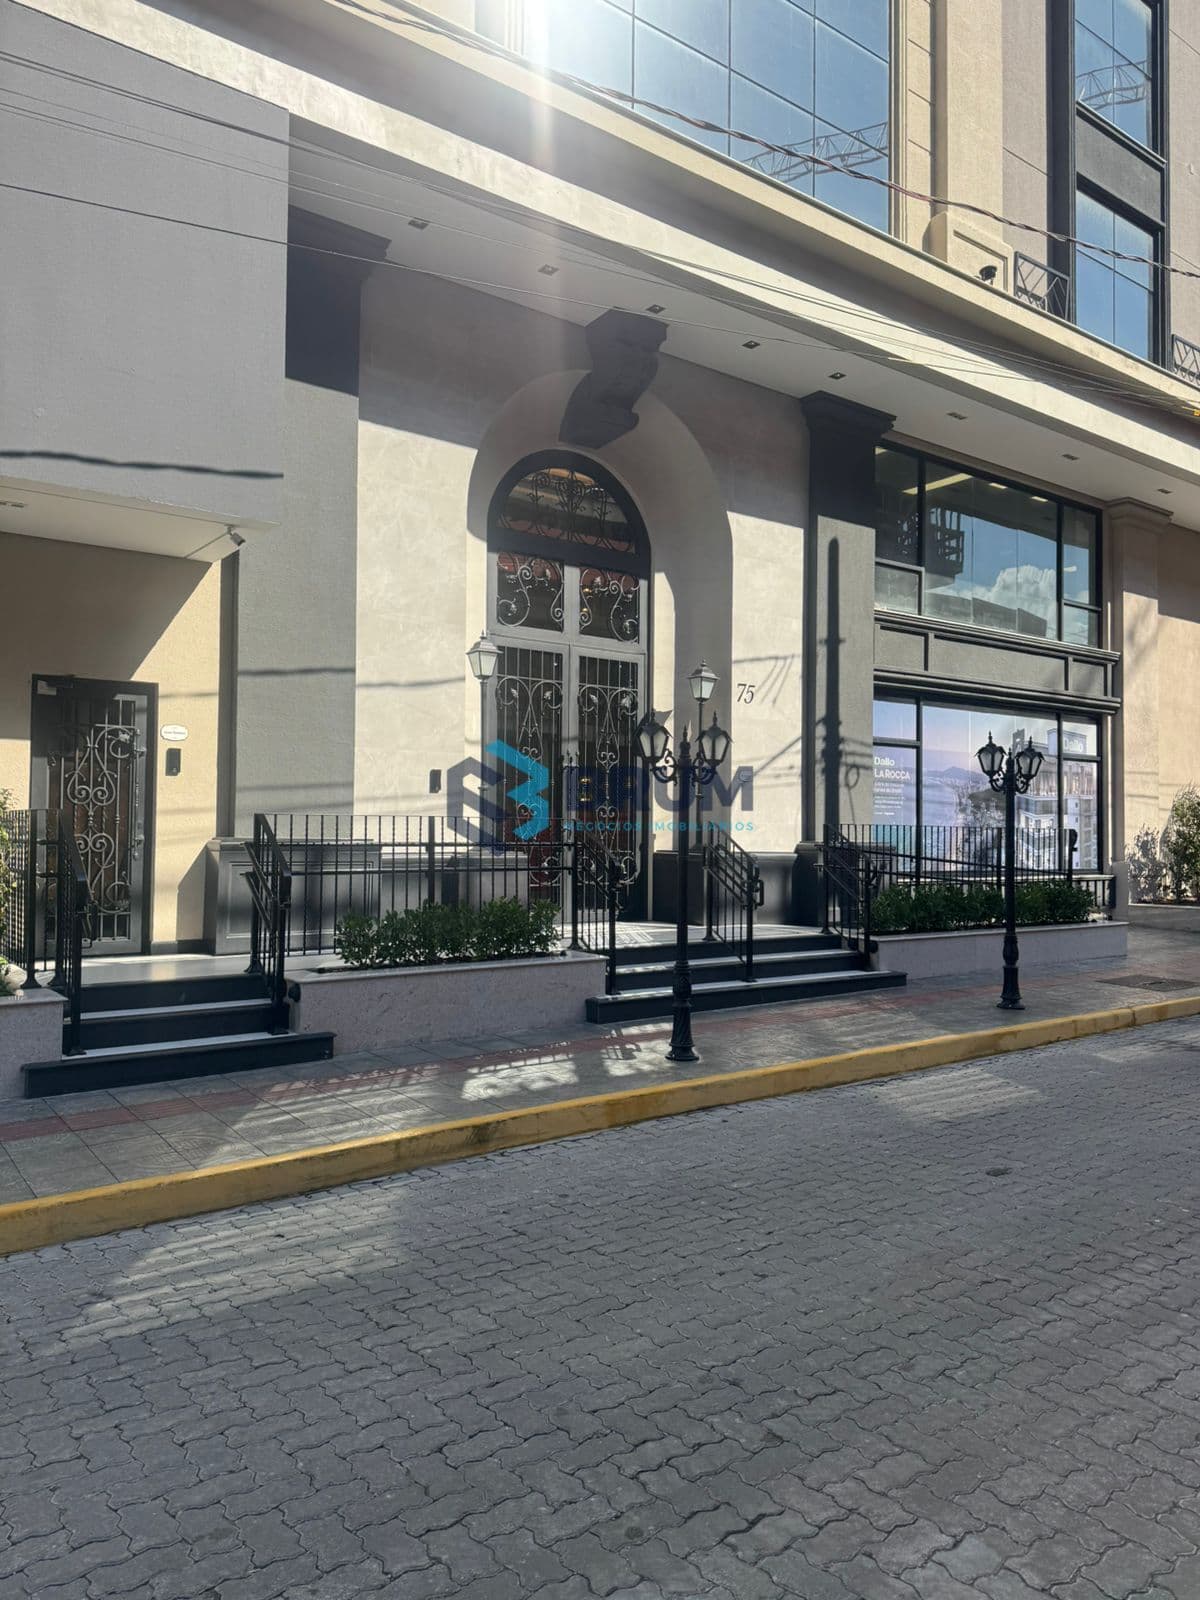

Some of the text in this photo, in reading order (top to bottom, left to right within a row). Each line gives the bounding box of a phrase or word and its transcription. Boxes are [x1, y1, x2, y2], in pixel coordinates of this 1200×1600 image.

[737, 683, 755, 704] 75
[874, 756, 895, 767] Dallo
[874, 768, 911, 780] LA ROCCA
